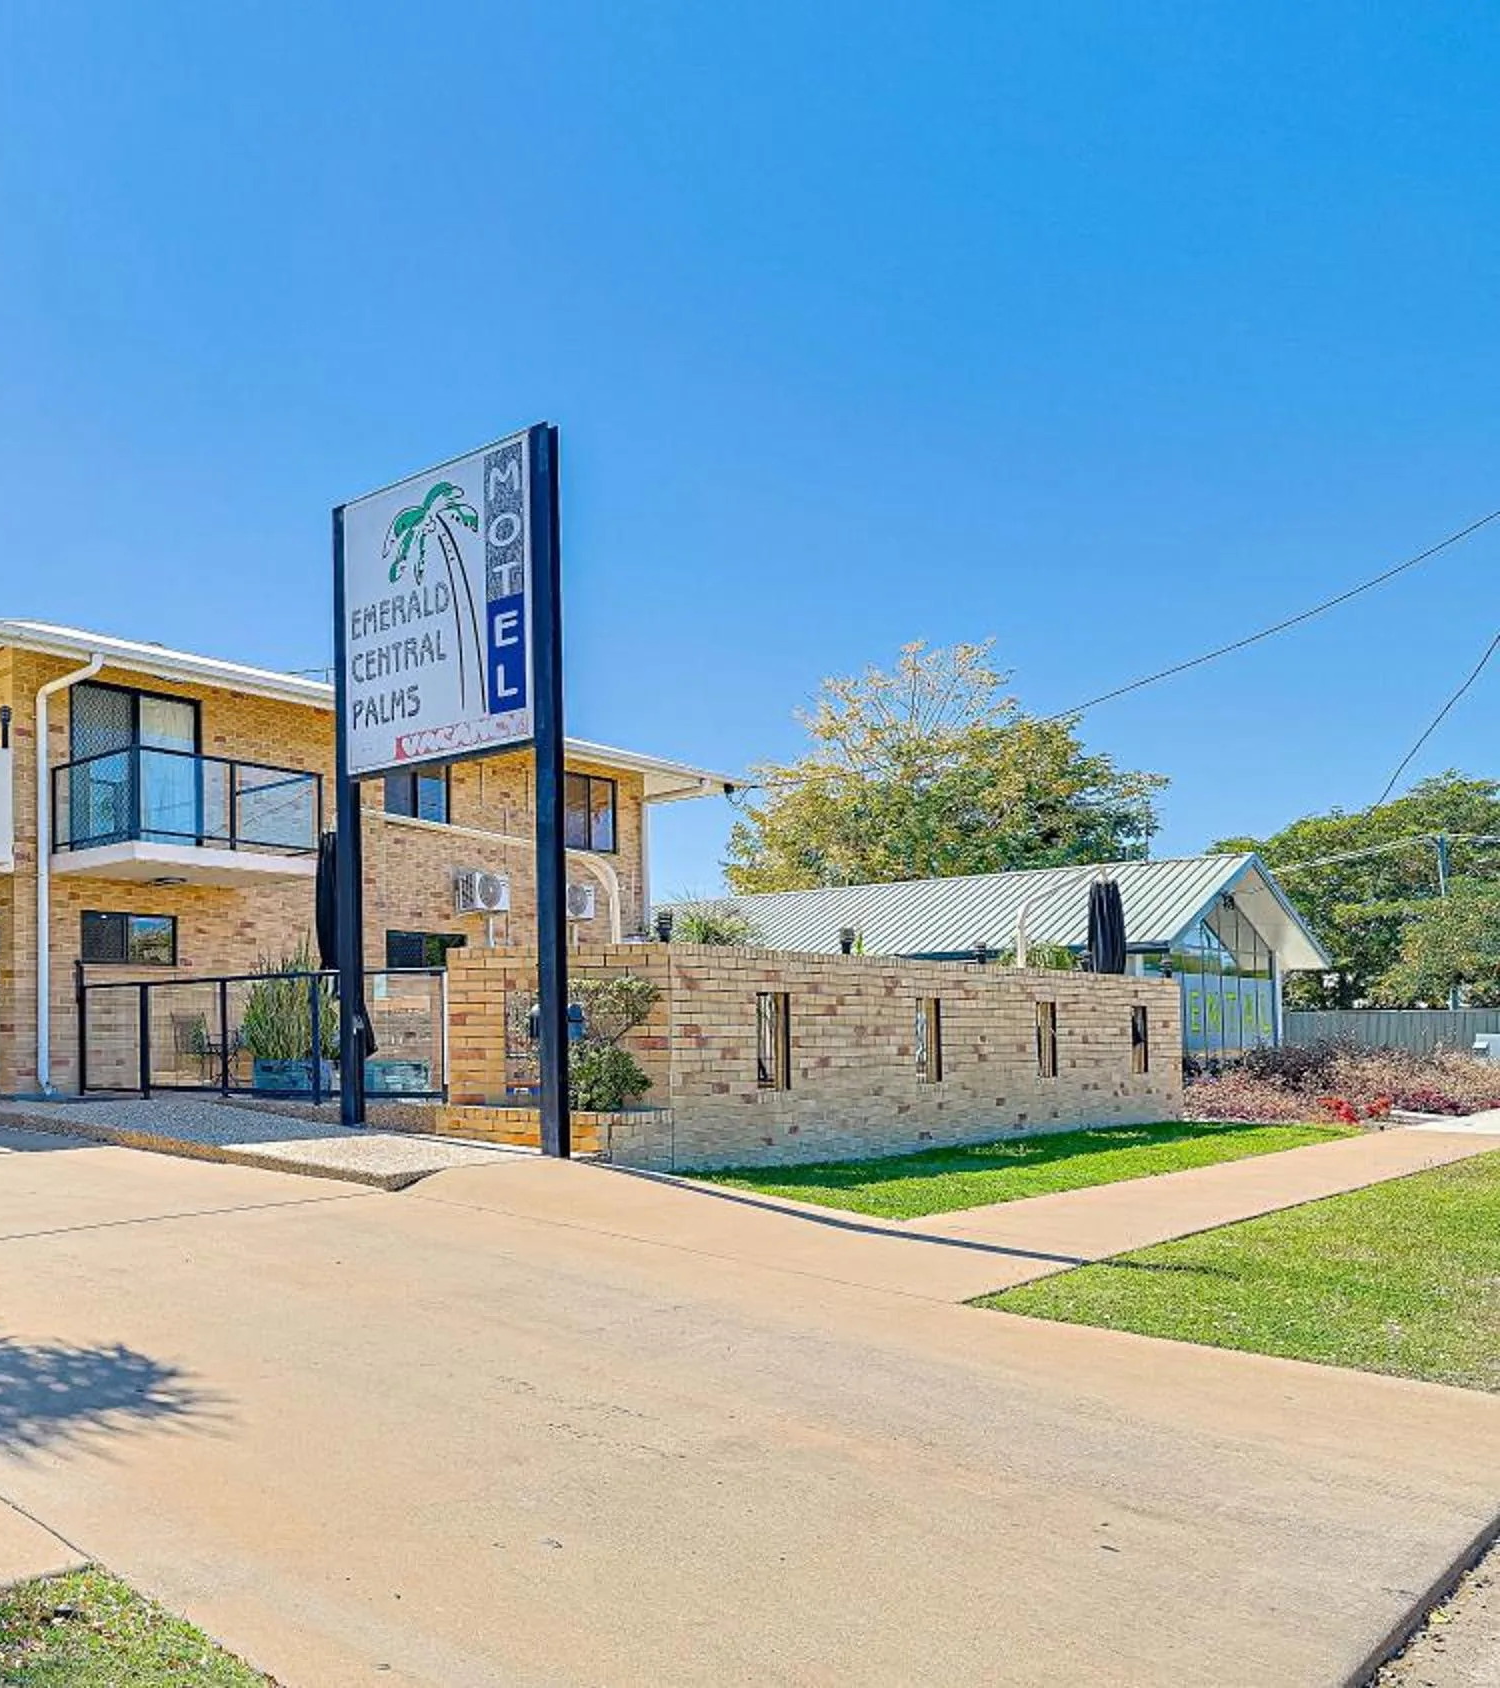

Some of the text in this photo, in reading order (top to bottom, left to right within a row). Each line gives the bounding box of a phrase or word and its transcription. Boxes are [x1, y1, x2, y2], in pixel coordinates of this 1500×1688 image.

[488, 459, 521, 698] MOTEL
[351, 581, 450, 640] EMERALD
[351, 629, 447, 683] CENTRAL
[352, 684, 421, 731] PALMS
